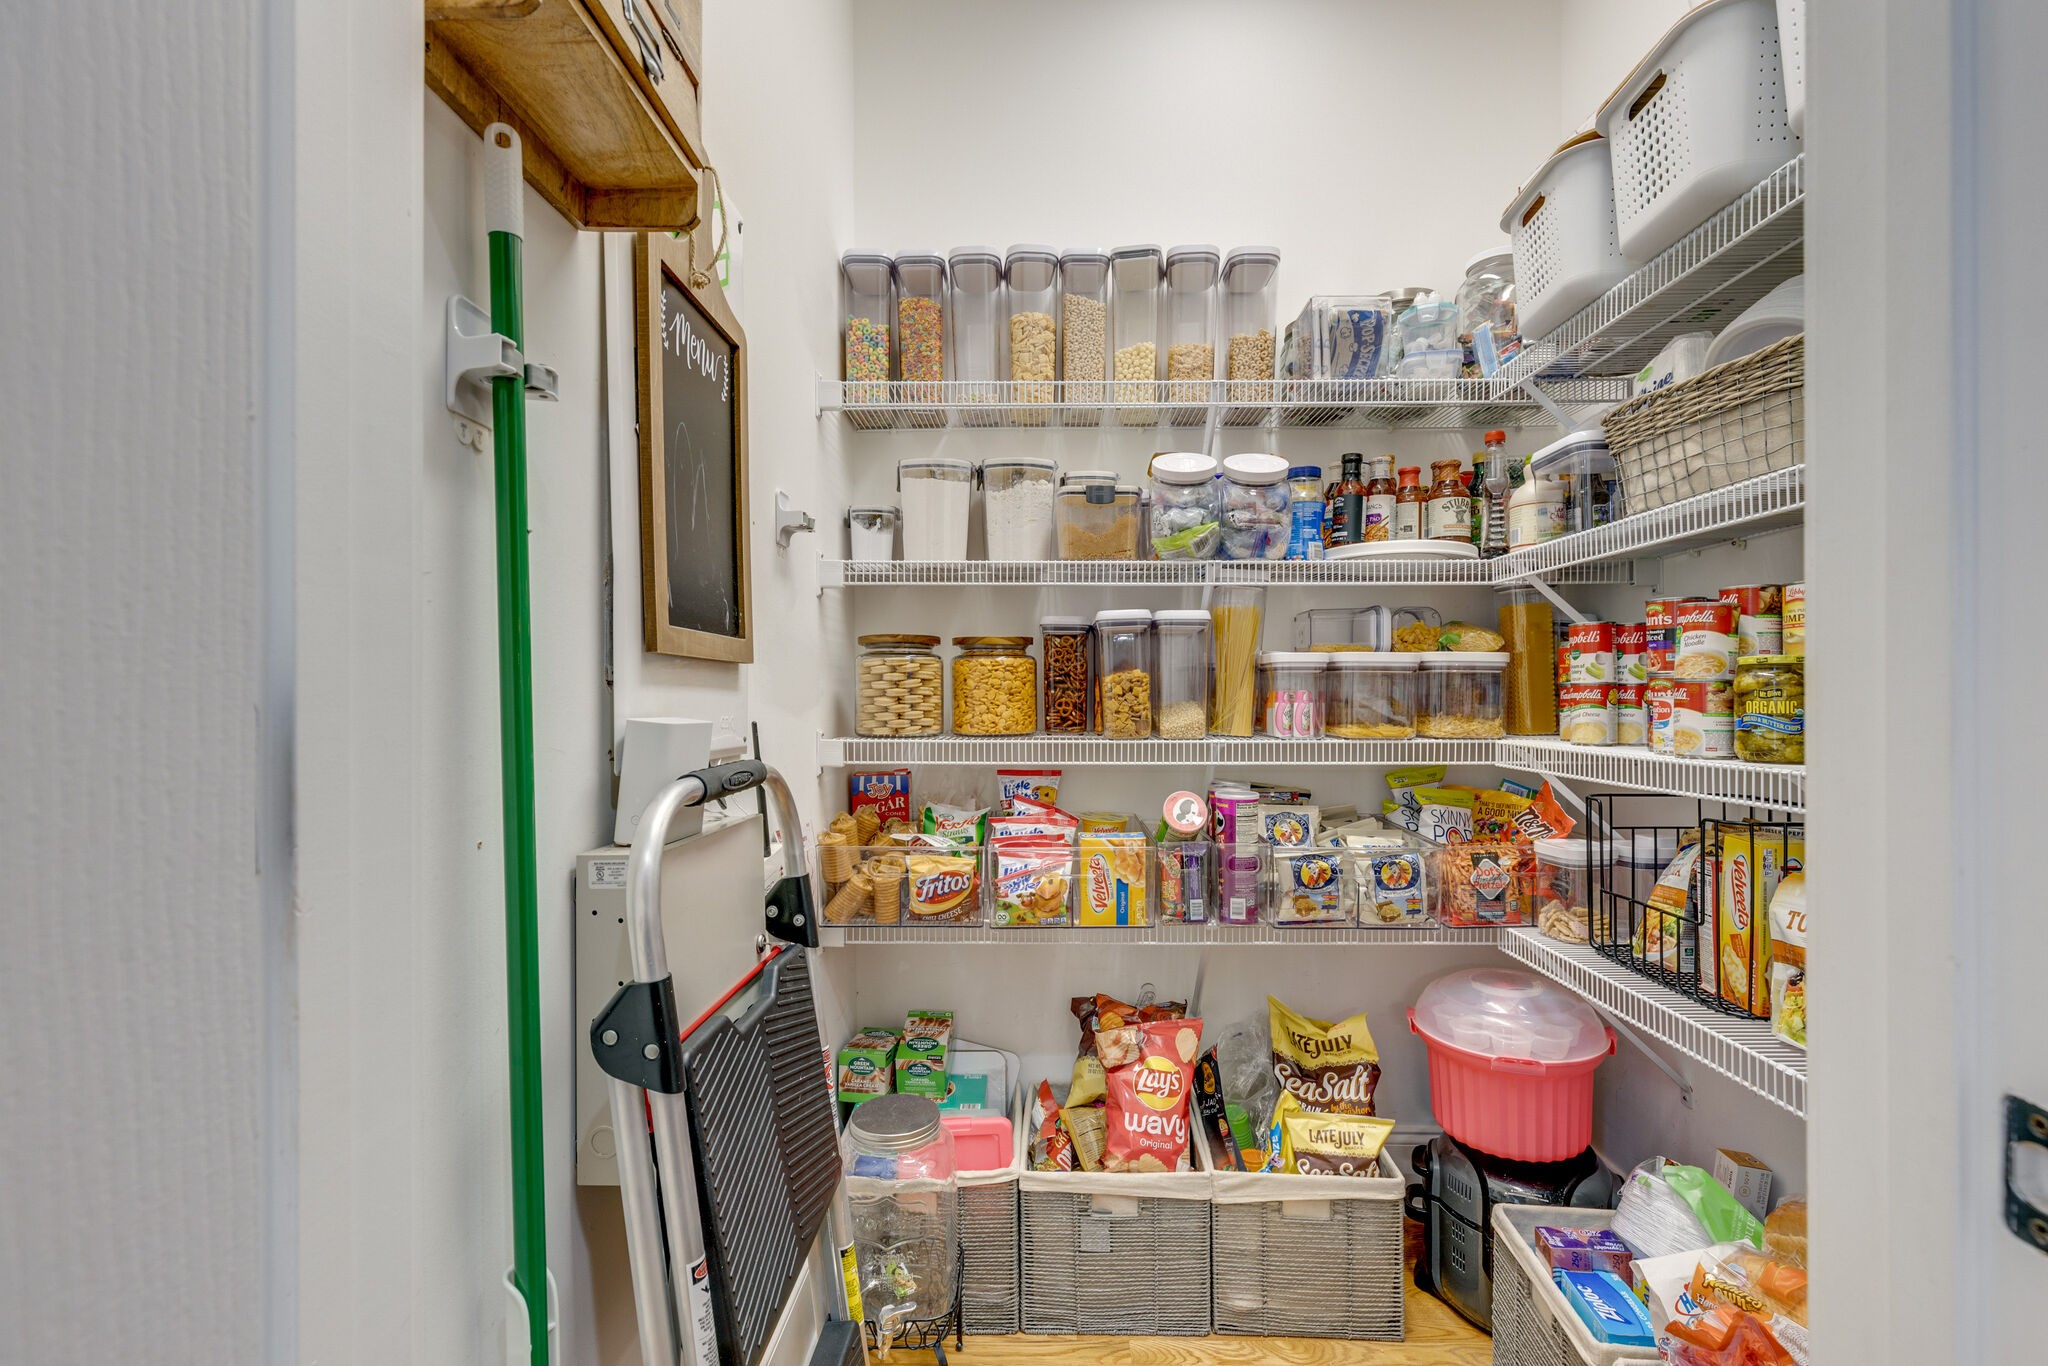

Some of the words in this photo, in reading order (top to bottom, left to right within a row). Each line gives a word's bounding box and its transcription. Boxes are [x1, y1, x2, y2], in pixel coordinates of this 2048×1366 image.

[669, 312, 722, 382] Menu
[1646, 612, 1673, 626] unt's
[1647, 633, 1664, 641] iced
[1745, 700, 1798, 714] ORGANIC
[1477, 807, 1483, 816] A
[1485, 808, 1505, 818] GOOD
[1479, 800, 1495, 808] THAT'S
[1430, 809, 1472, 829] SKINNY
[1475, 865, 1501, 877] Dot's
[915, 871, 970, 902] Fritos
[1089, 856, 1109, 909] Velveeta
[1473, 880, 1508, 890] Pretzels
[1733, 859, 1749, 927] Velveeta
[938, 907, 963, 920] CHEESE
[1310, 1034, 1352, 1059] JULY
[1137, 1069, 1180, 1098] Lay's
[1274, 1063, 1317, 1101] Sea
[1315, 1065, 1371, 1102] Salt
[1140, 1138, 1173, 1150] Original
[1308, 1128, 1336, 1144] LATE
[1334, 1131, 1365, 1149] JULY
[1571, 1251, 1580, 1268] 250
[1612, 1254, 1621, 1270] 250
[1577, 1284, 1625, 1322] Ziploc
